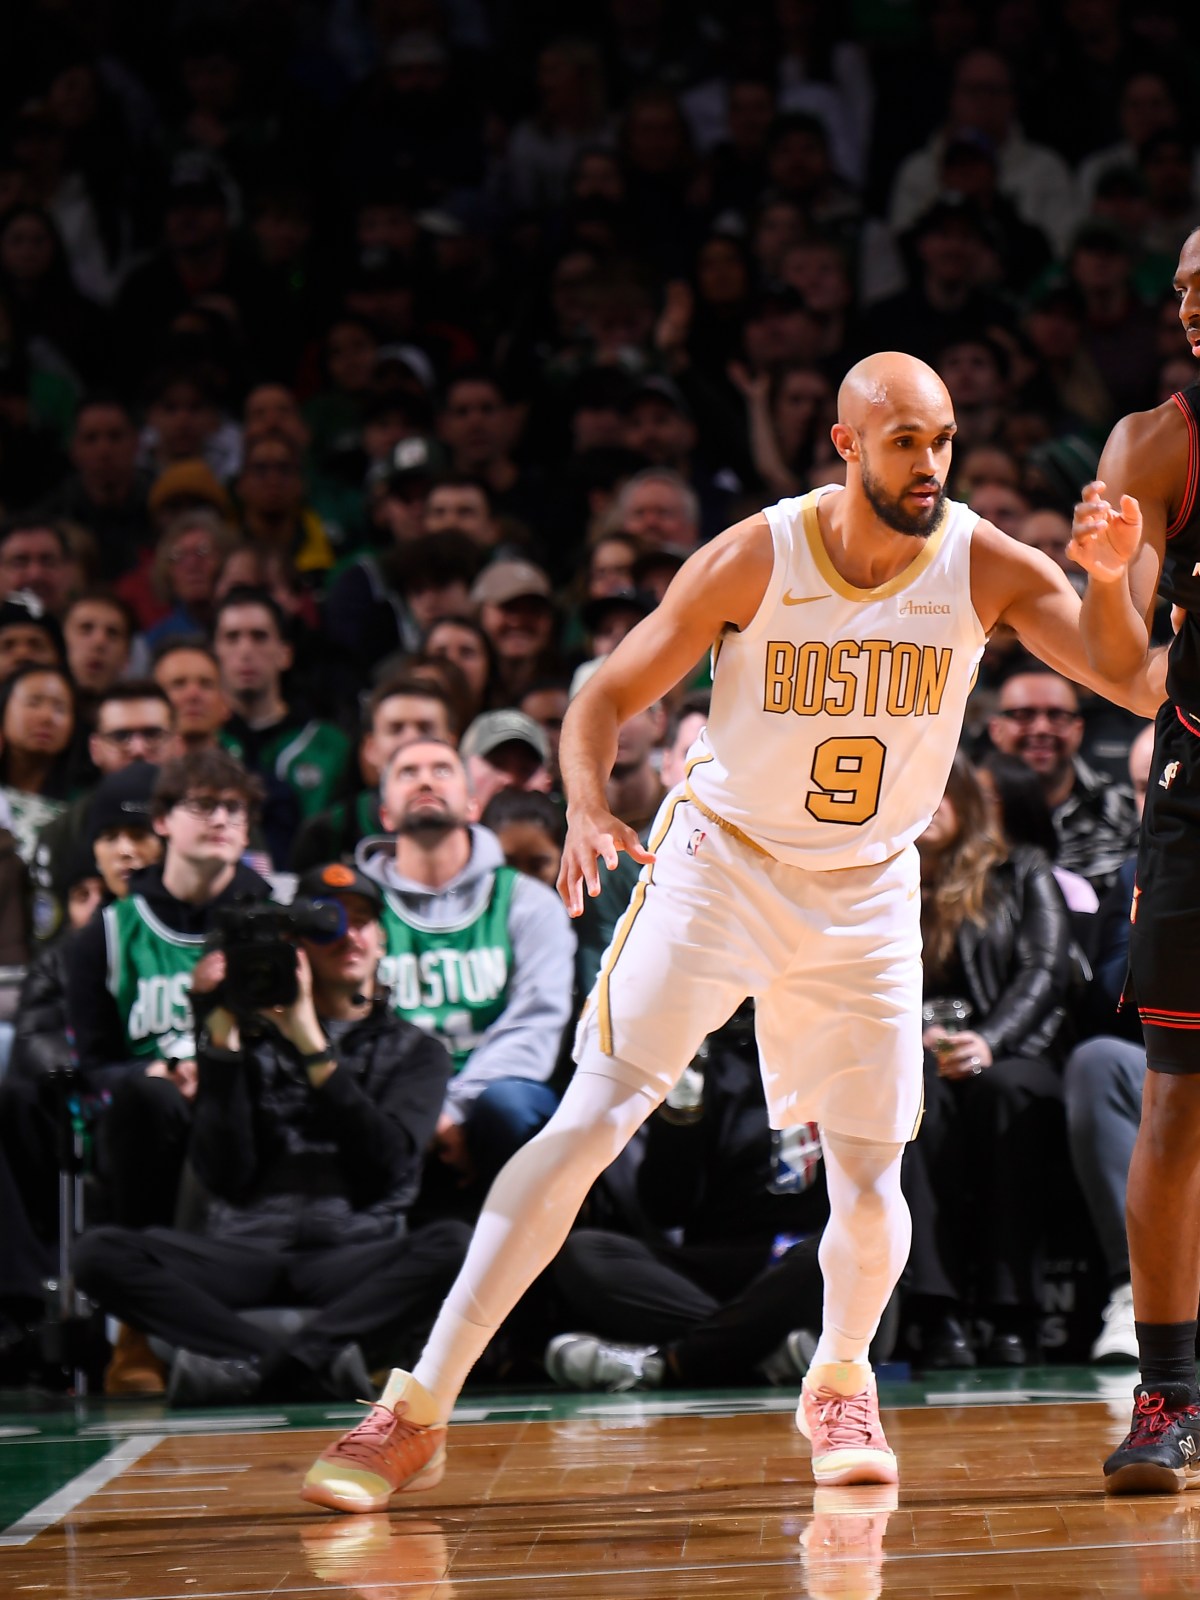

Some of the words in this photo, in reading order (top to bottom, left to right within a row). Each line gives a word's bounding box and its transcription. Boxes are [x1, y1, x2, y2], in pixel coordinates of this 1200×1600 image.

[899, 600, 951, 616] Amica
[763, 639, 953, 717] BOSTON
[804, 736, 887, 826] 9
